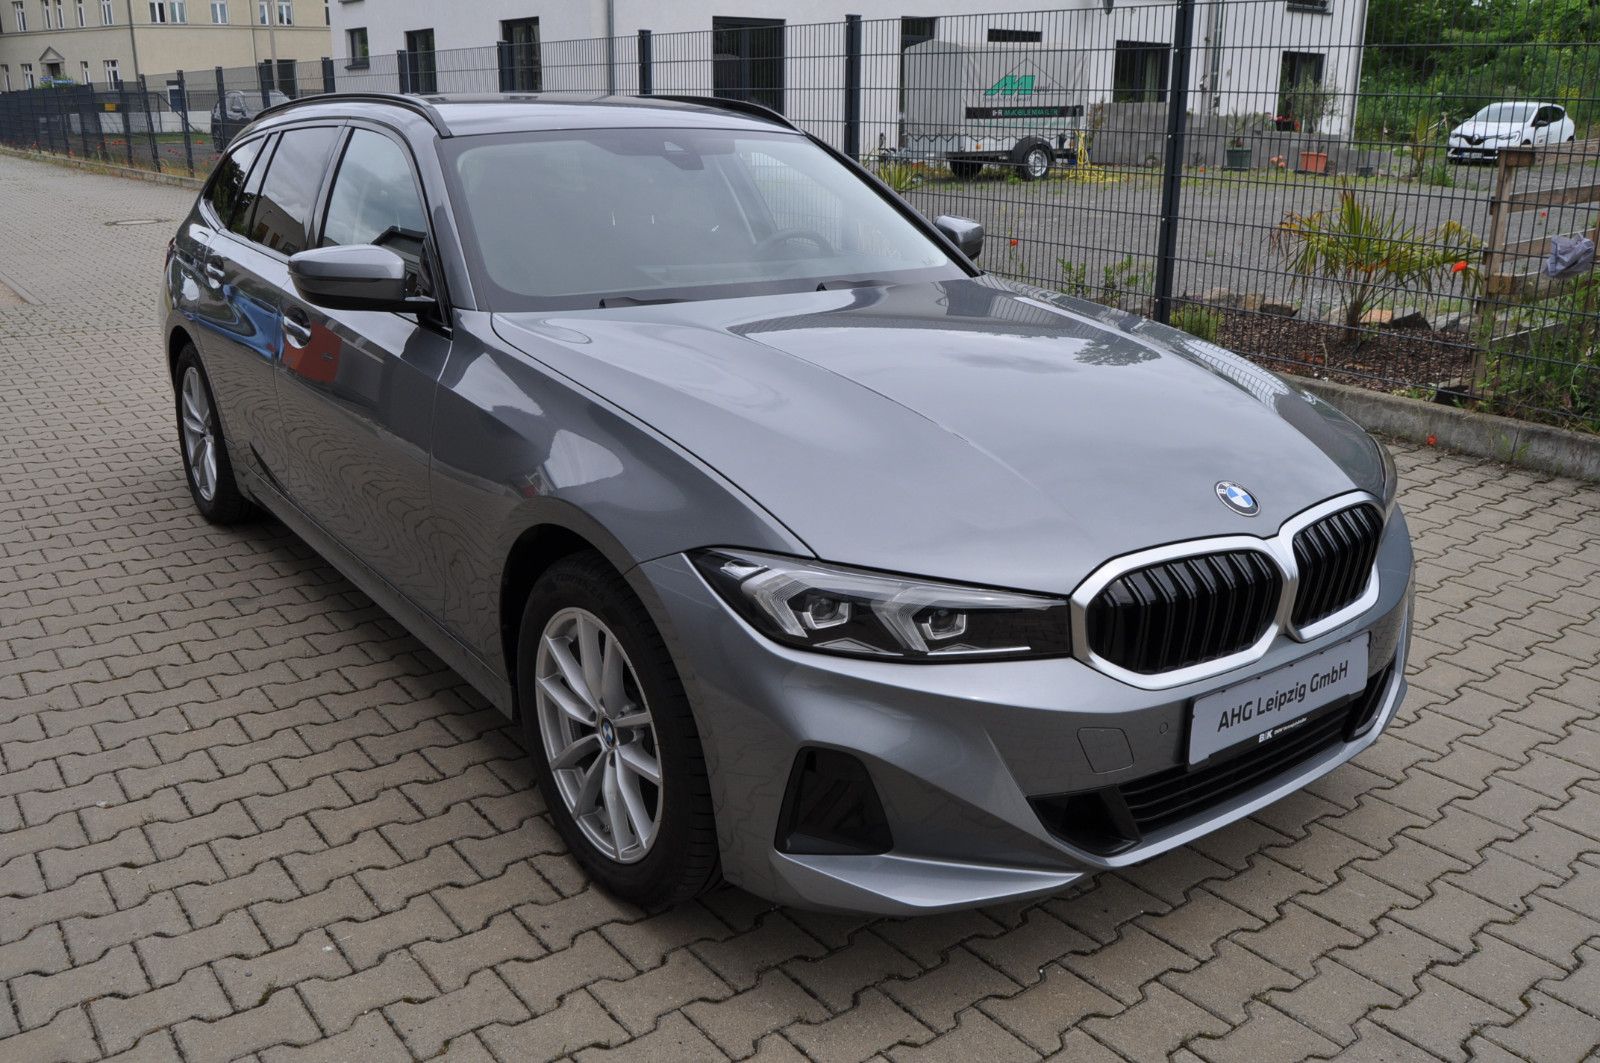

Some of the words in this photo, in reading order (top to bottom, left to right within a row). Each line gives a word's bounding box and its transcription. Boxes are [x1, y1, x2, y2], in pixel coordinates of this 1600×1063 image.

[1217, 701, 1253, 732] AHG
[1256, 682, 1306, 716] Leipzig
[1310, 660, 1348, 692] GmbH
